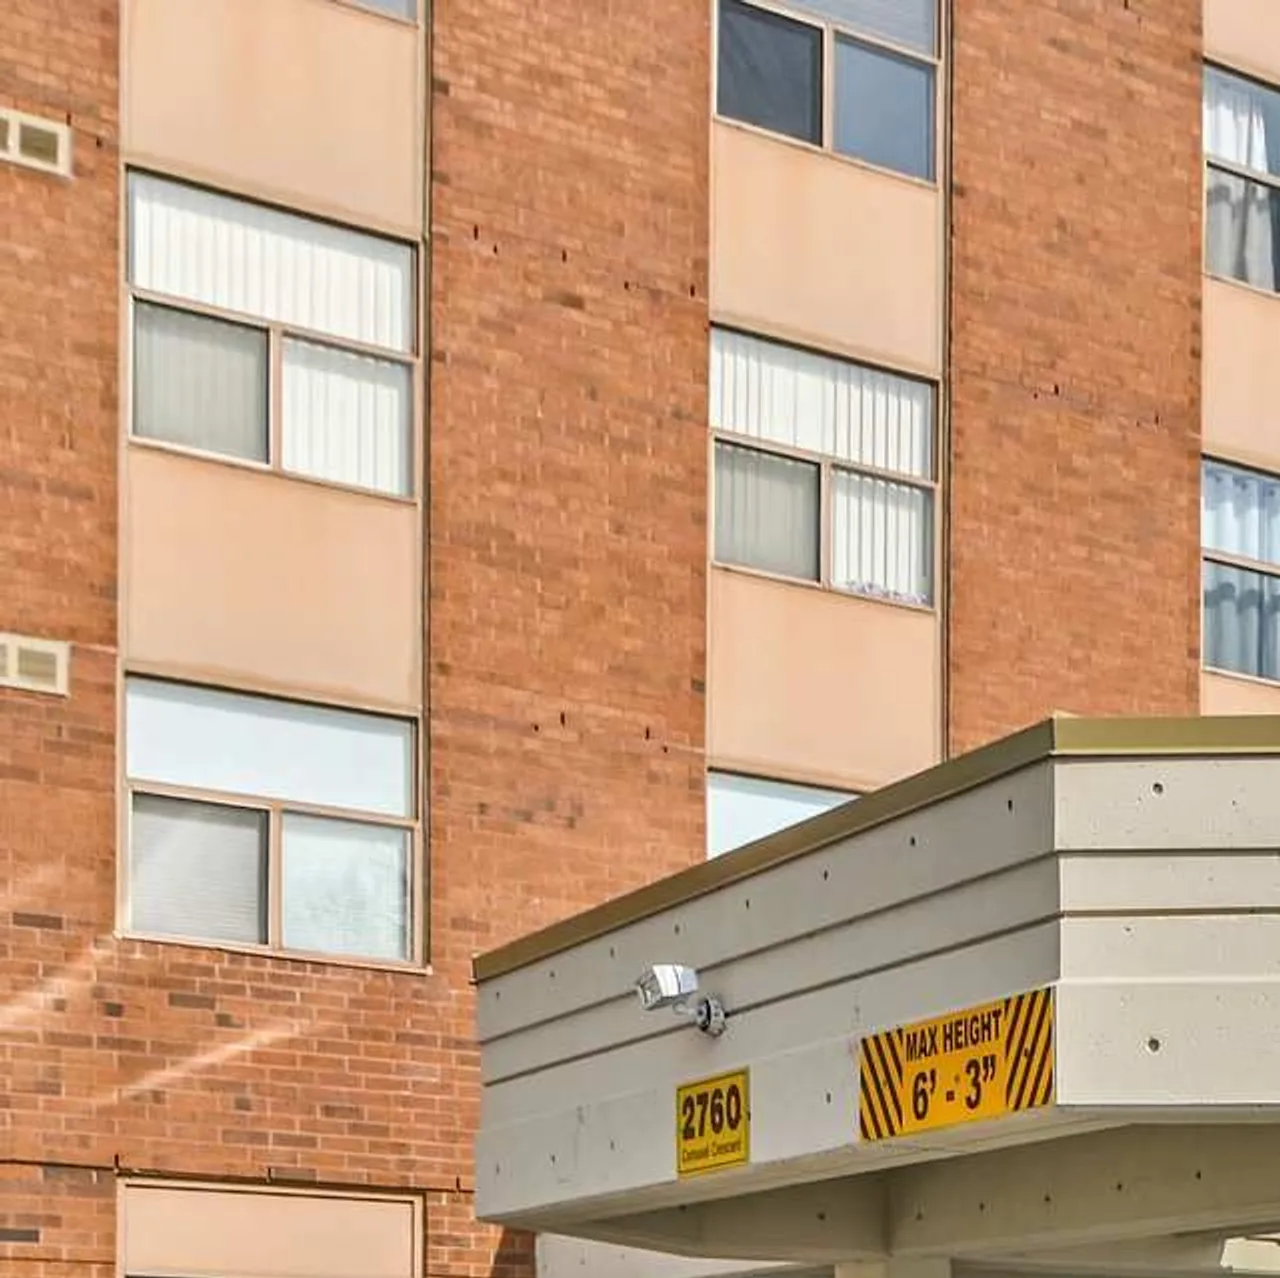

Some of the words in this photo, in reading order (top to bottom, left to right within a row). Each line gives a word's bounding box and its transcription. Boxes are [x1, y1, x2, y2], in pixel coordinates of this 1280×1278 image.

[906, 1025, 938, 1062] MAX
[943, 1008, 1001, 1053] HEIGHT
[683, 1084, 741, 1139] 2760
